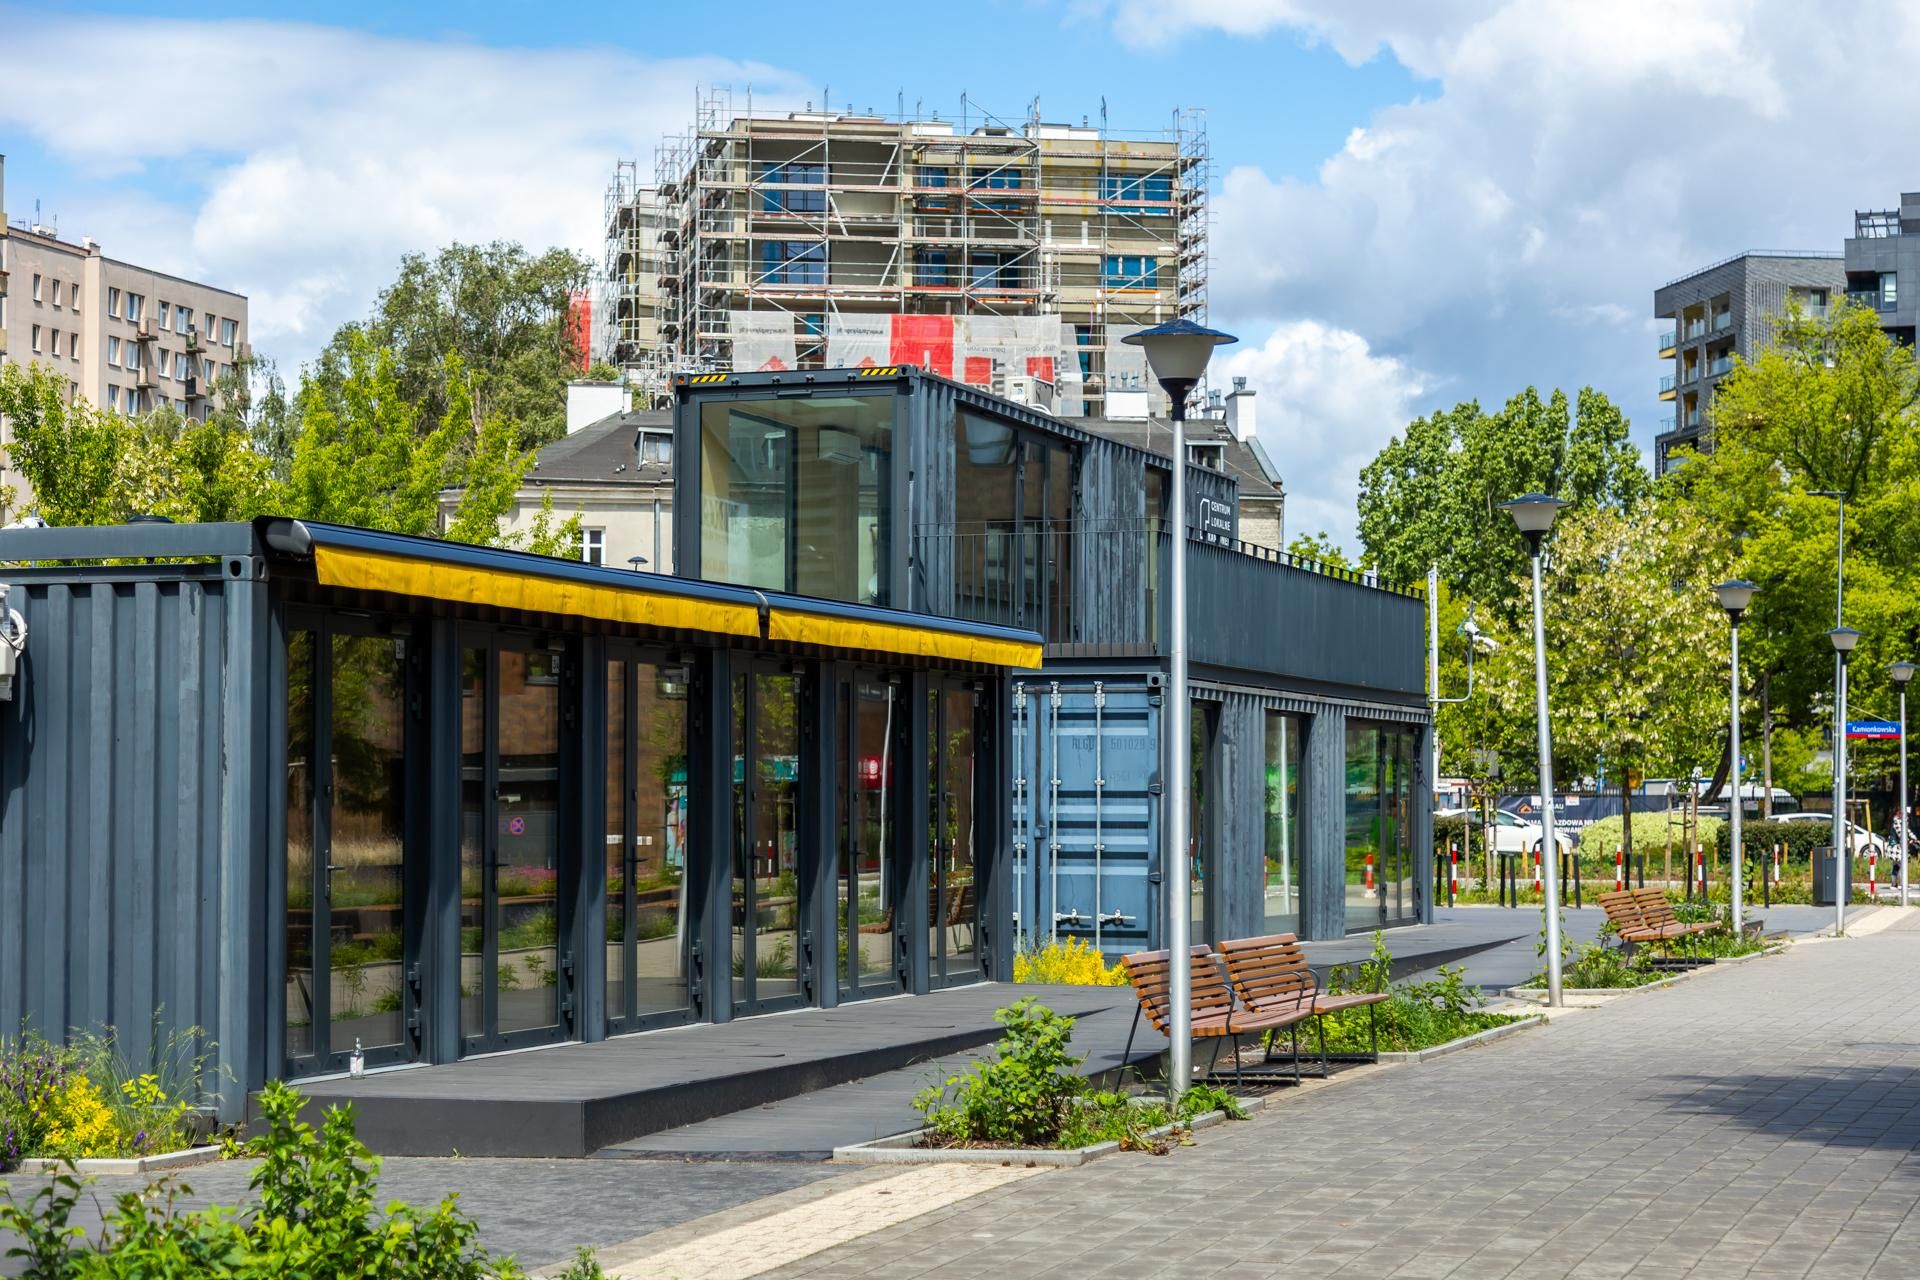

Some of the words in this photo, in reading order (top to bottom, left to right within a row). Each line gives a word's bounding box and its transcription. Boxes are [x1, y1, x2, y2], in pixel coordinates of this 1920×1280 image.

[1211, 501, 1231, 516] CENTRUM
[1211, 517, 1231, 531] LOKALNE
[1852, 725, 1896, 733] Kamionkowska
